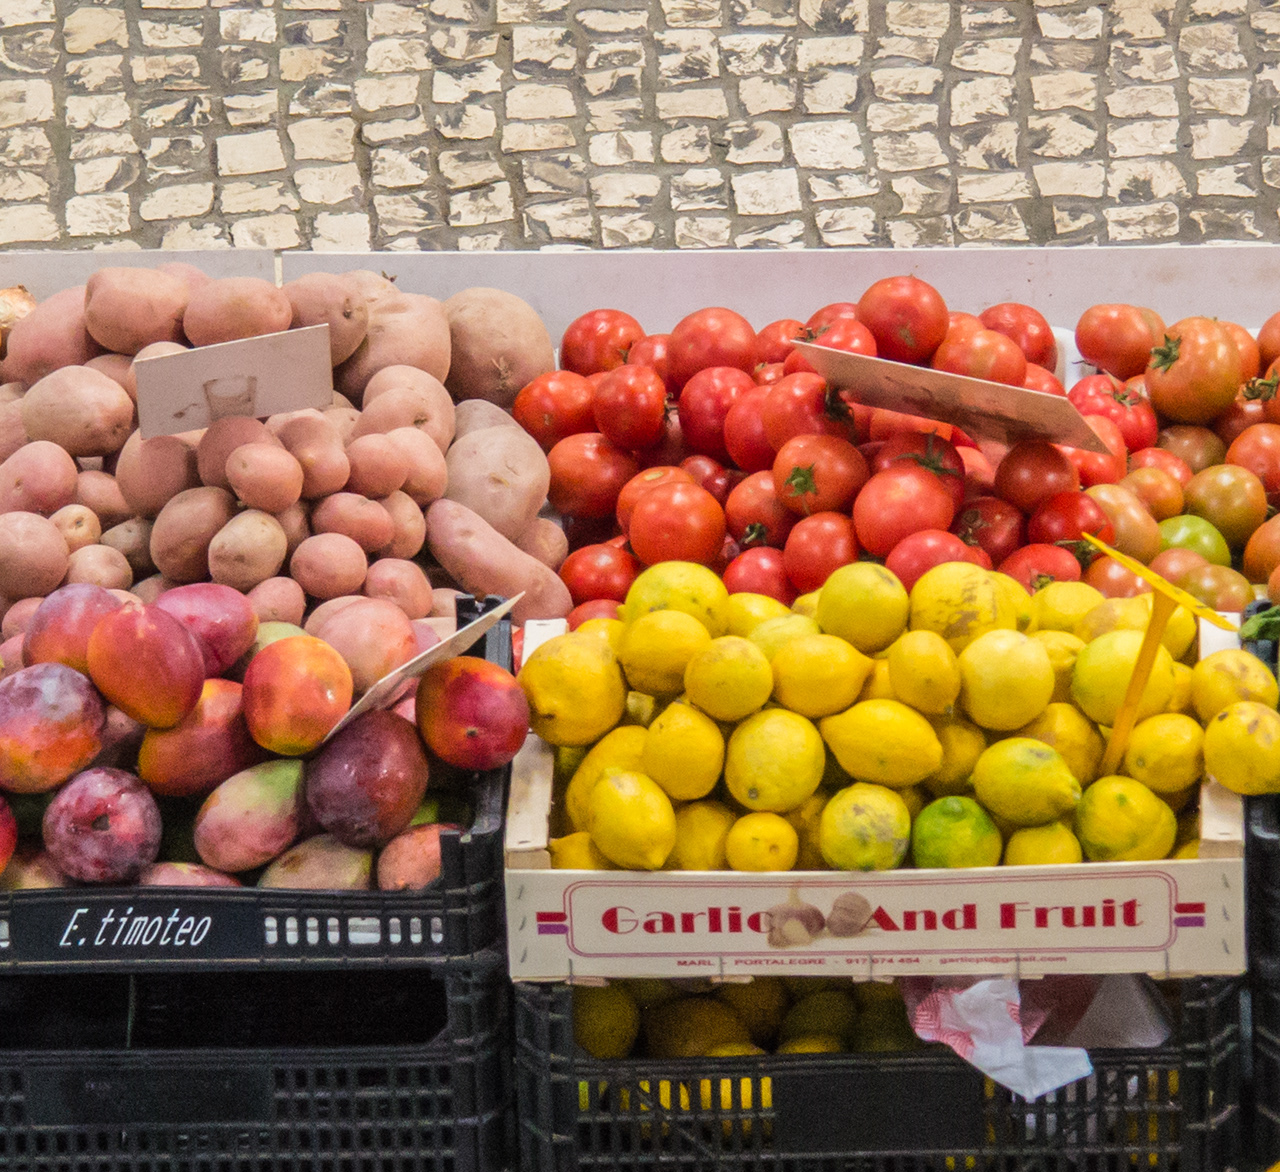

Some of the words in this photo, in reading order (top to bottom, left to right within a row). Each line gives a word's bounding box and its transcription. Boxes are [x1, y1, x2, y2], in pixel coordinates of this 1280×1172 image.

[58, 906, 212, 946] E.timoteo
[601, 905, 773, 934] Garlic
[862, 902, 977, 931] And
[1000, 898, 1144, 929] Fruit
[734, 958, 827, 967] PORTALEGRE
